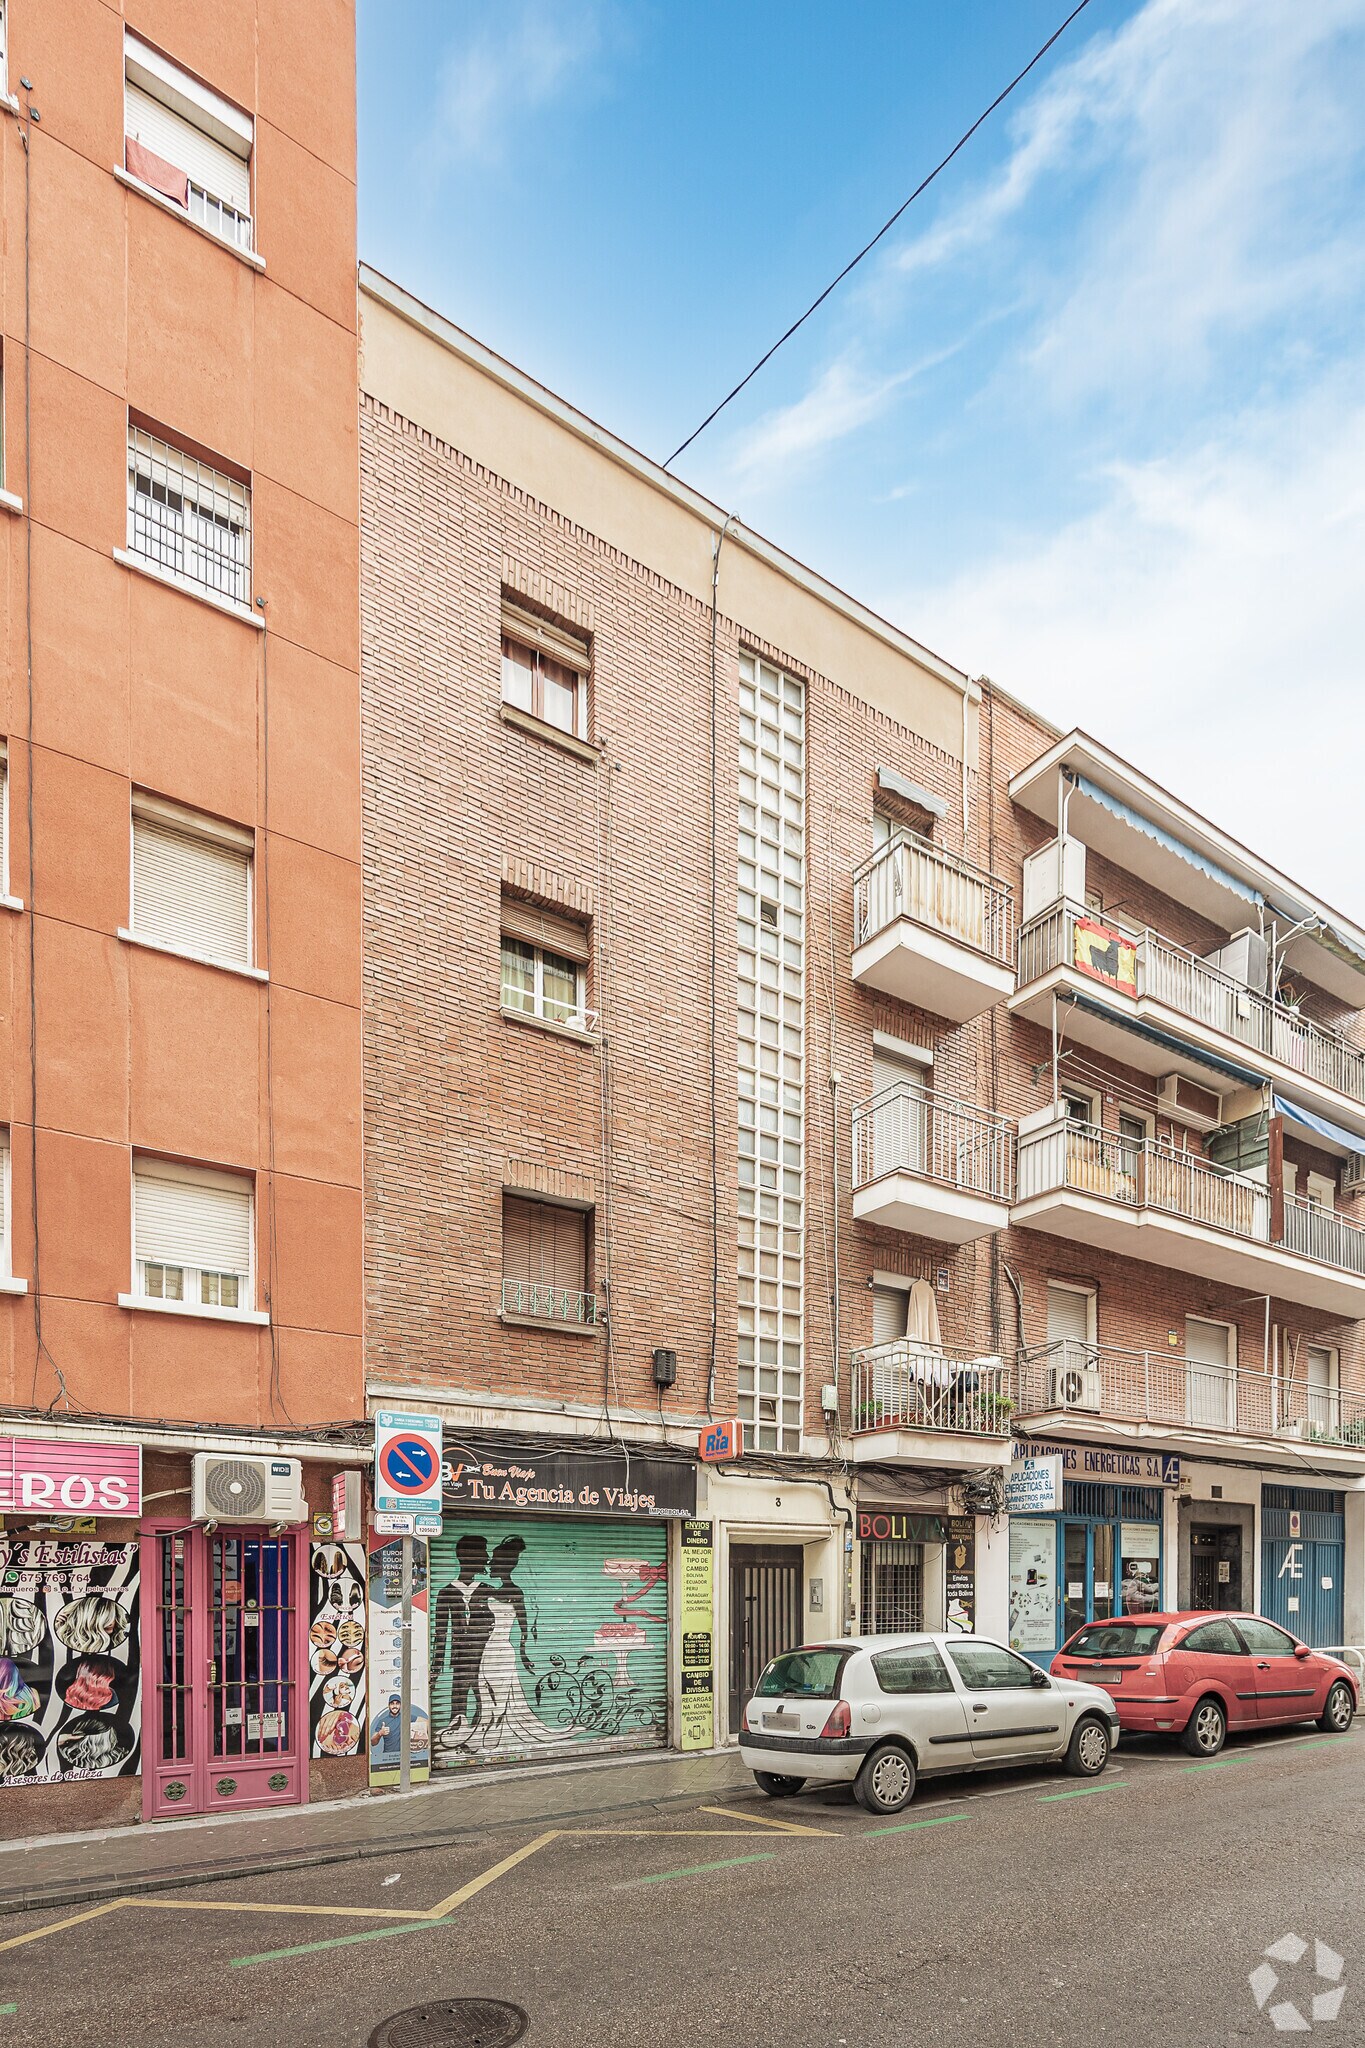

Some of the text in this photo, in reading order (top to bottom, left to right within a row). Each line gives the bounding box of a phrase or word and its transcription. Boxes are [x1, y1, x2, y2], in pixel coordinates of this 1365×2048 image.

[706, 1426, 729, 1452] Ria
[508, 1465, 536, 1481] Viaje
[1010, 1469, 1050, 1483] APLICACIONES
[467, 1479, 656, 1512] Tu Agencia de Viajes
[1040, 1493, 1054, 1501] PARA
[775, 1497, 782, 1507] 3
[860, 1514, 947, 1541] BOLIVIA
[686, 1537, 708, 1545] DINERO
[20, 1573, 90, 1583] 675 769 764
[686, 1671, 710, 1679] CAMBIO
[686, 1686, 710, 1694] DIVISAS
[3, 1768, 103, 1786] Asesores de Belleza
